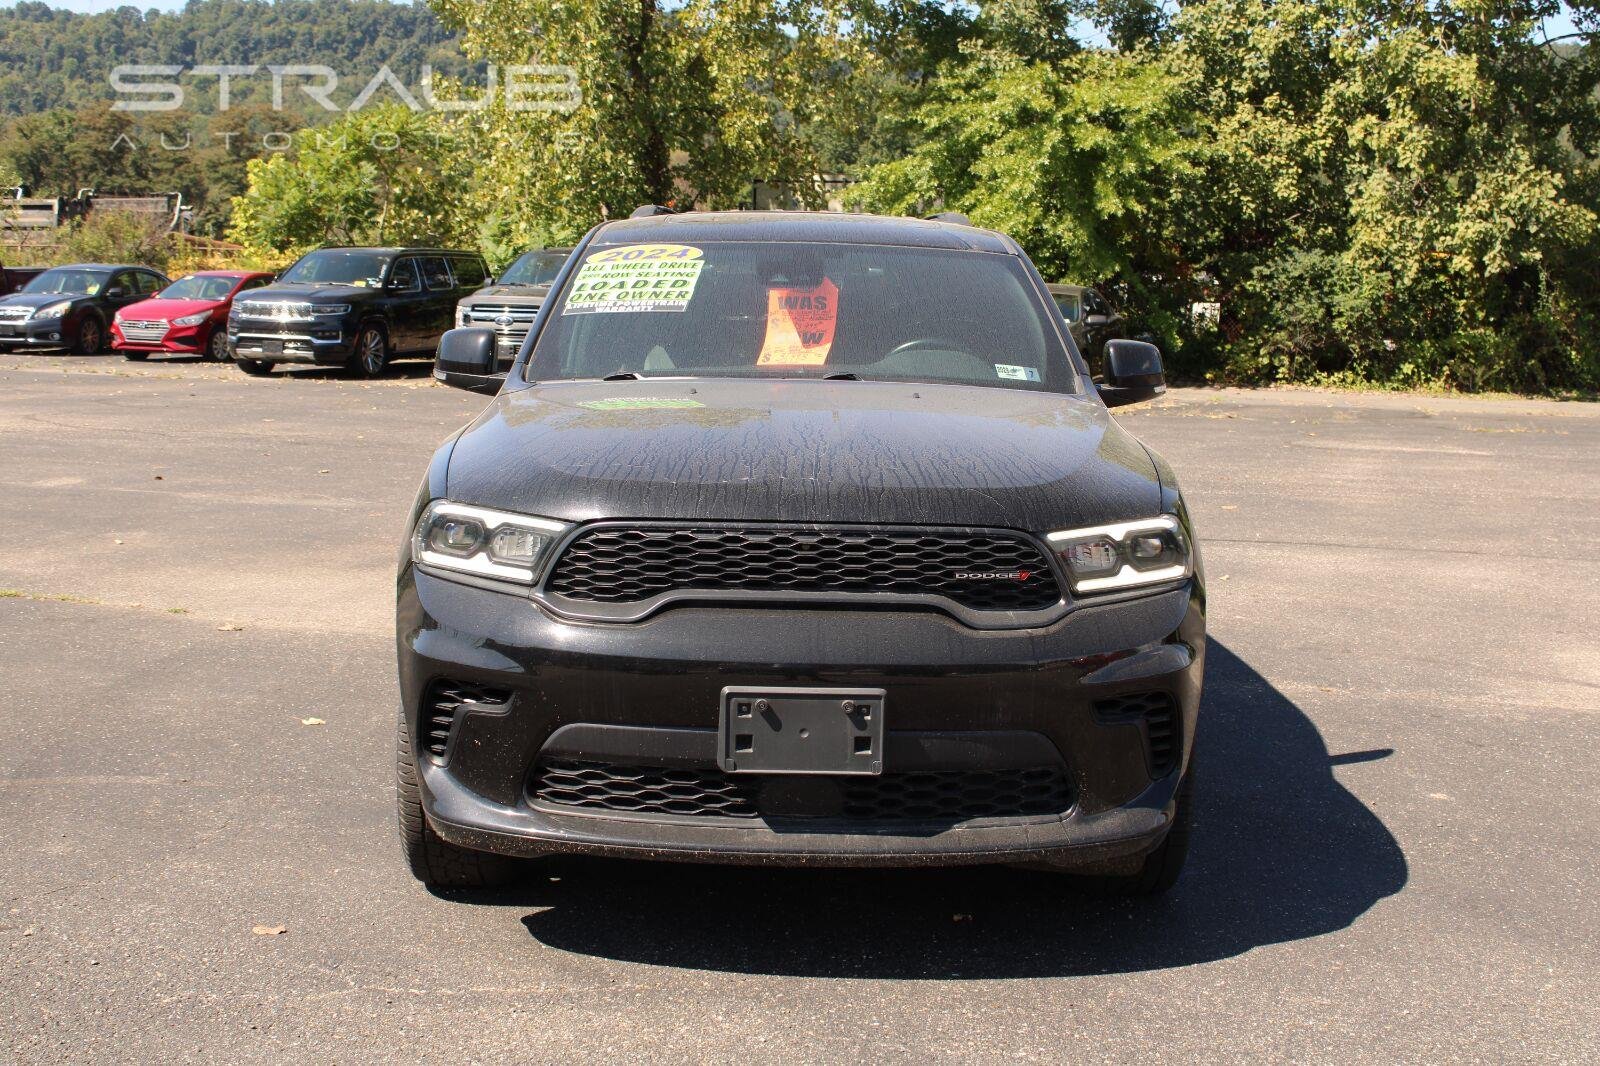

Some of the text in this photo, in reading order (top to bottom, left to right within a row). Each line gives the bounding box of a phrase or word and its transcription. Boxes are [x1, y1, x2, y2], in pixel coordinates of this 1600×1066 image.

[600, 249, 690, 262] 2024
[583, 264, 606, 272] ALL
[658, 261, 699, 269] DRIVE
[576, 280, 688, 292] LOADED
[570, 291, 689, 303] ONE OWNER
[777, 295, 827, 310] WAS
